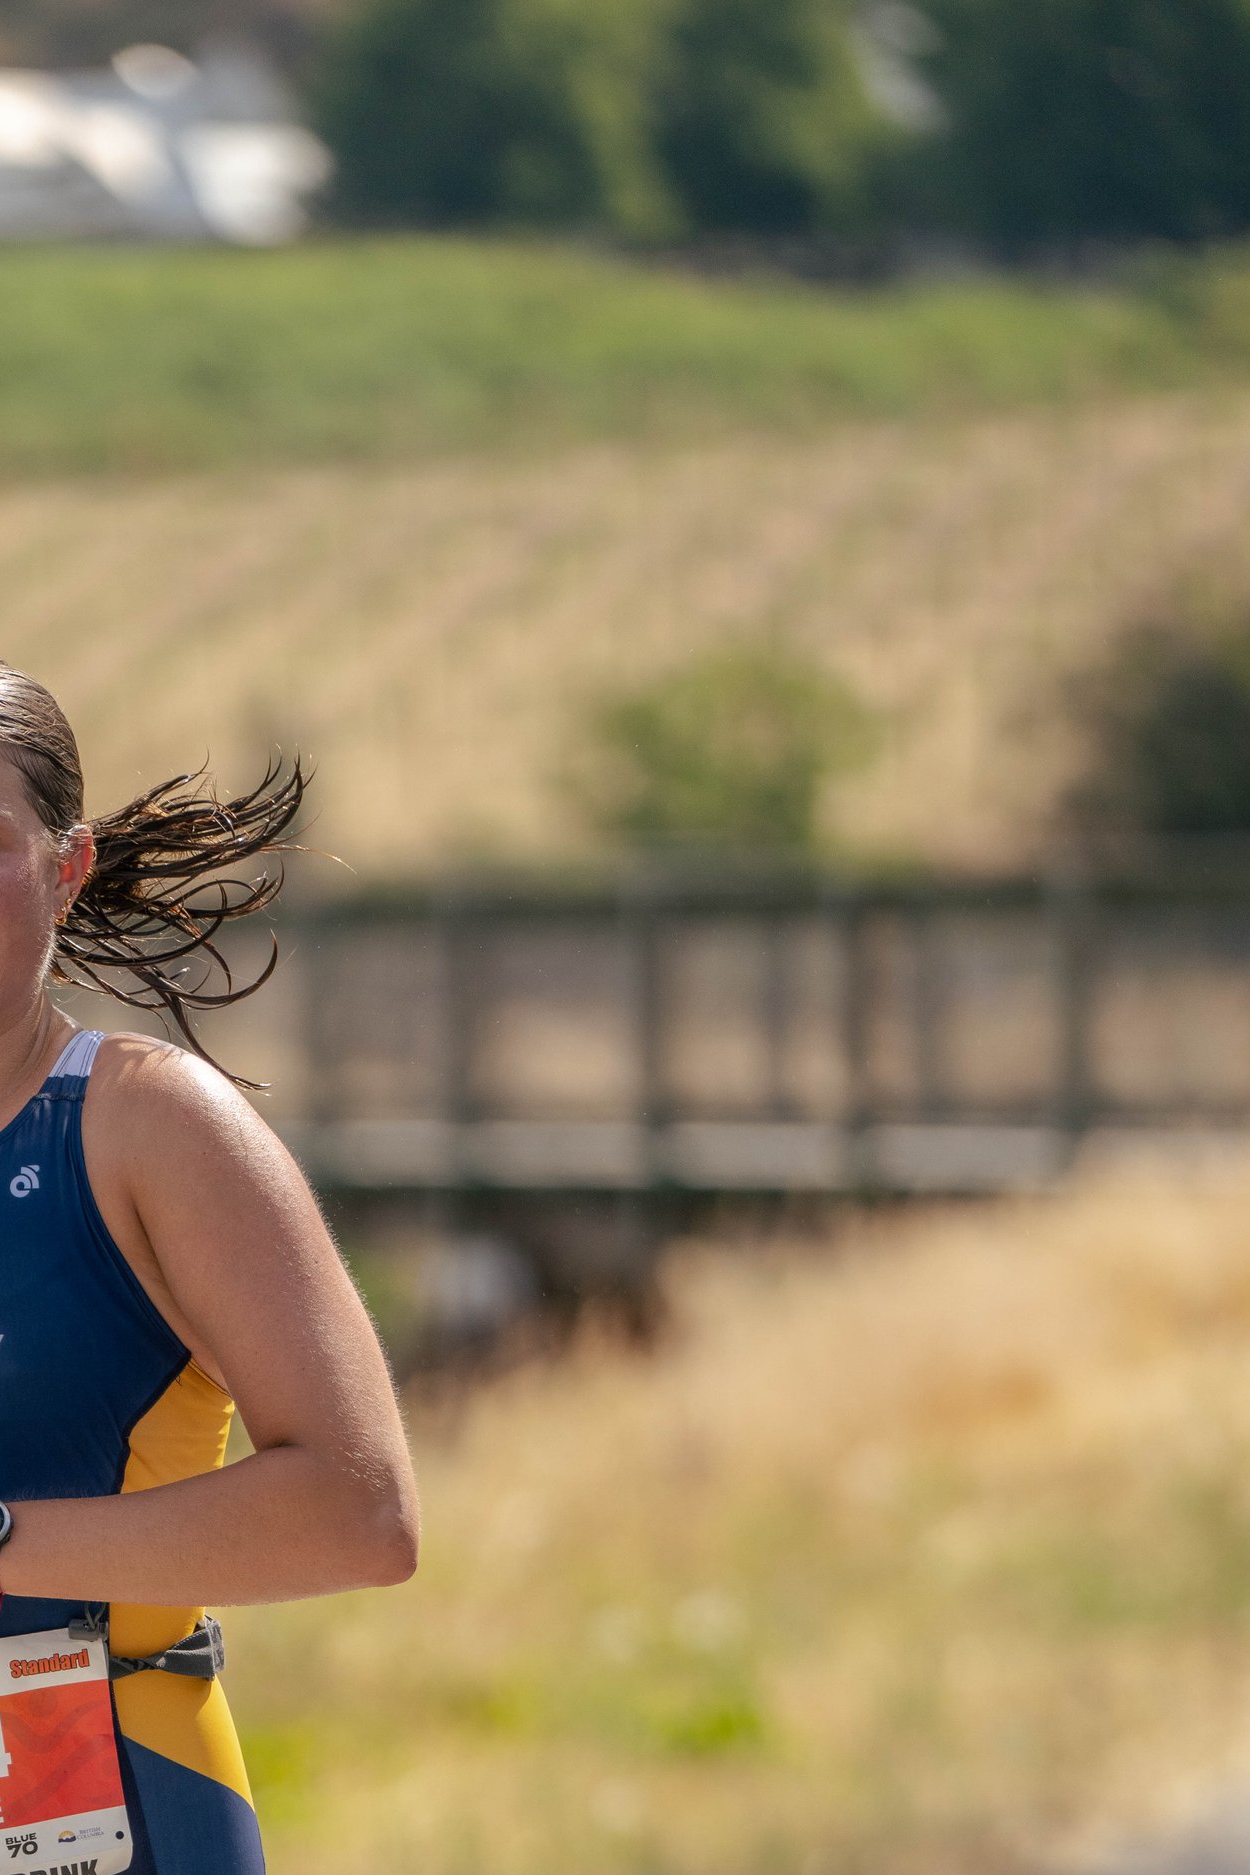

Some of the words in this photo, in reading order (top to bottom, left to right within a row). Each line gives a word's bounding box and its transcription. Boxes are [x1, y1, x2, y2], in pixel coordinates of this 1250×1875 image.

[10, 1648, 90, 1679] Standard
[5, 1832, 37, 1845] BLUE
[7, 1841, 38, 1858] 70
